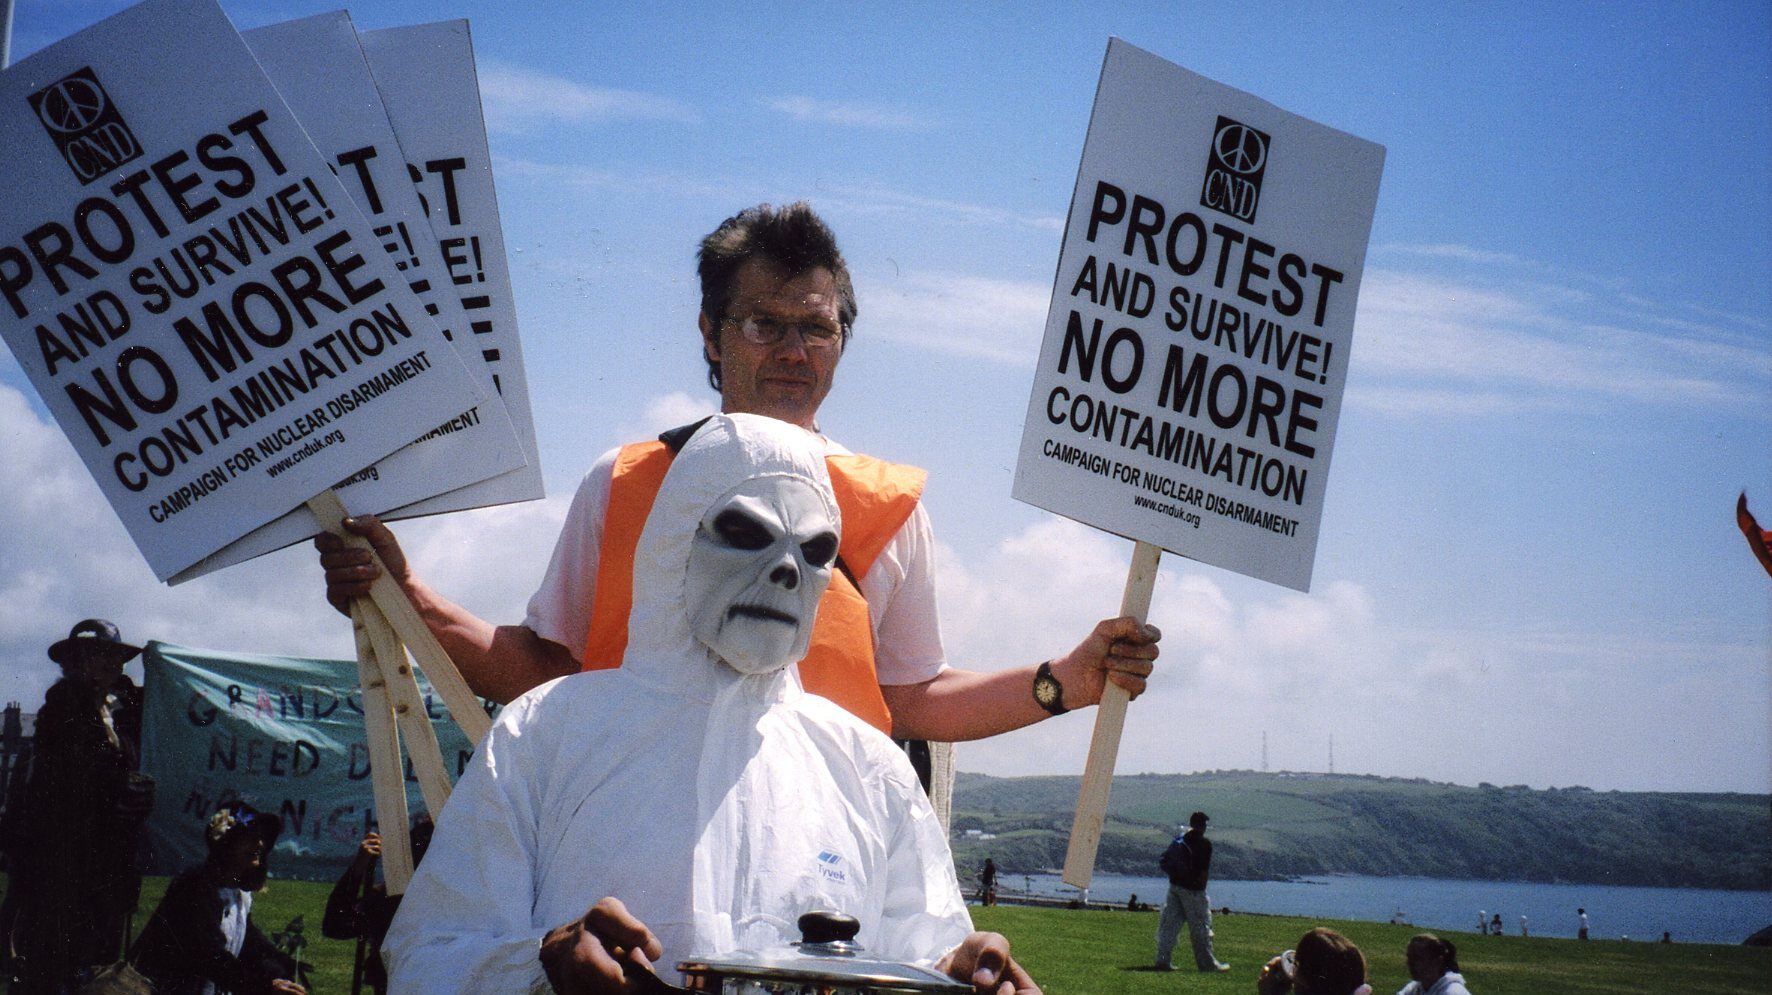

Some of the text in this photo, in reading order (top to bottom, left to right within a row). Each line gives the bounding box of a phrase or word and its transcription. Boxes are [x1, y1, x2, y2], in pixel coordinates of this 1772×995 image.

[67, 121, 136, 179] CND
[1205, 169, 1256, 219] CND
[0, 109, 288, 320] PROTEST
[34, 290, 132, 377] AND
[128, 176, 335, 315] SURVIVE!
[1086, 180, 1344, 327] PROTEST
[64, 345, 179, 448] NO
[172, 230, 386, 384] MORE
[1070, 255, 1333, 385] AND SURVIVE!
[113, 302, 413, 493] CONTAMINATION
[149, 350, 432, 524] CAMPAIGN FOR NUCLEAR DISARMAMENT
[1046, 386, 1308, 506] CONTAMINATION
[1057, 310, 1324, 459] NO MORE
[265, 428, 345, 479] www.cnduk.org
[1043, 439, 1299, 538] CAMPAIGN FOR NUCLEAR DISARMAMENT
[1134, 495, 1201, 529] www.cnduk.org
[208, 735, 320, 778] NEED
[817, 863, 846, 881] Tyvek
